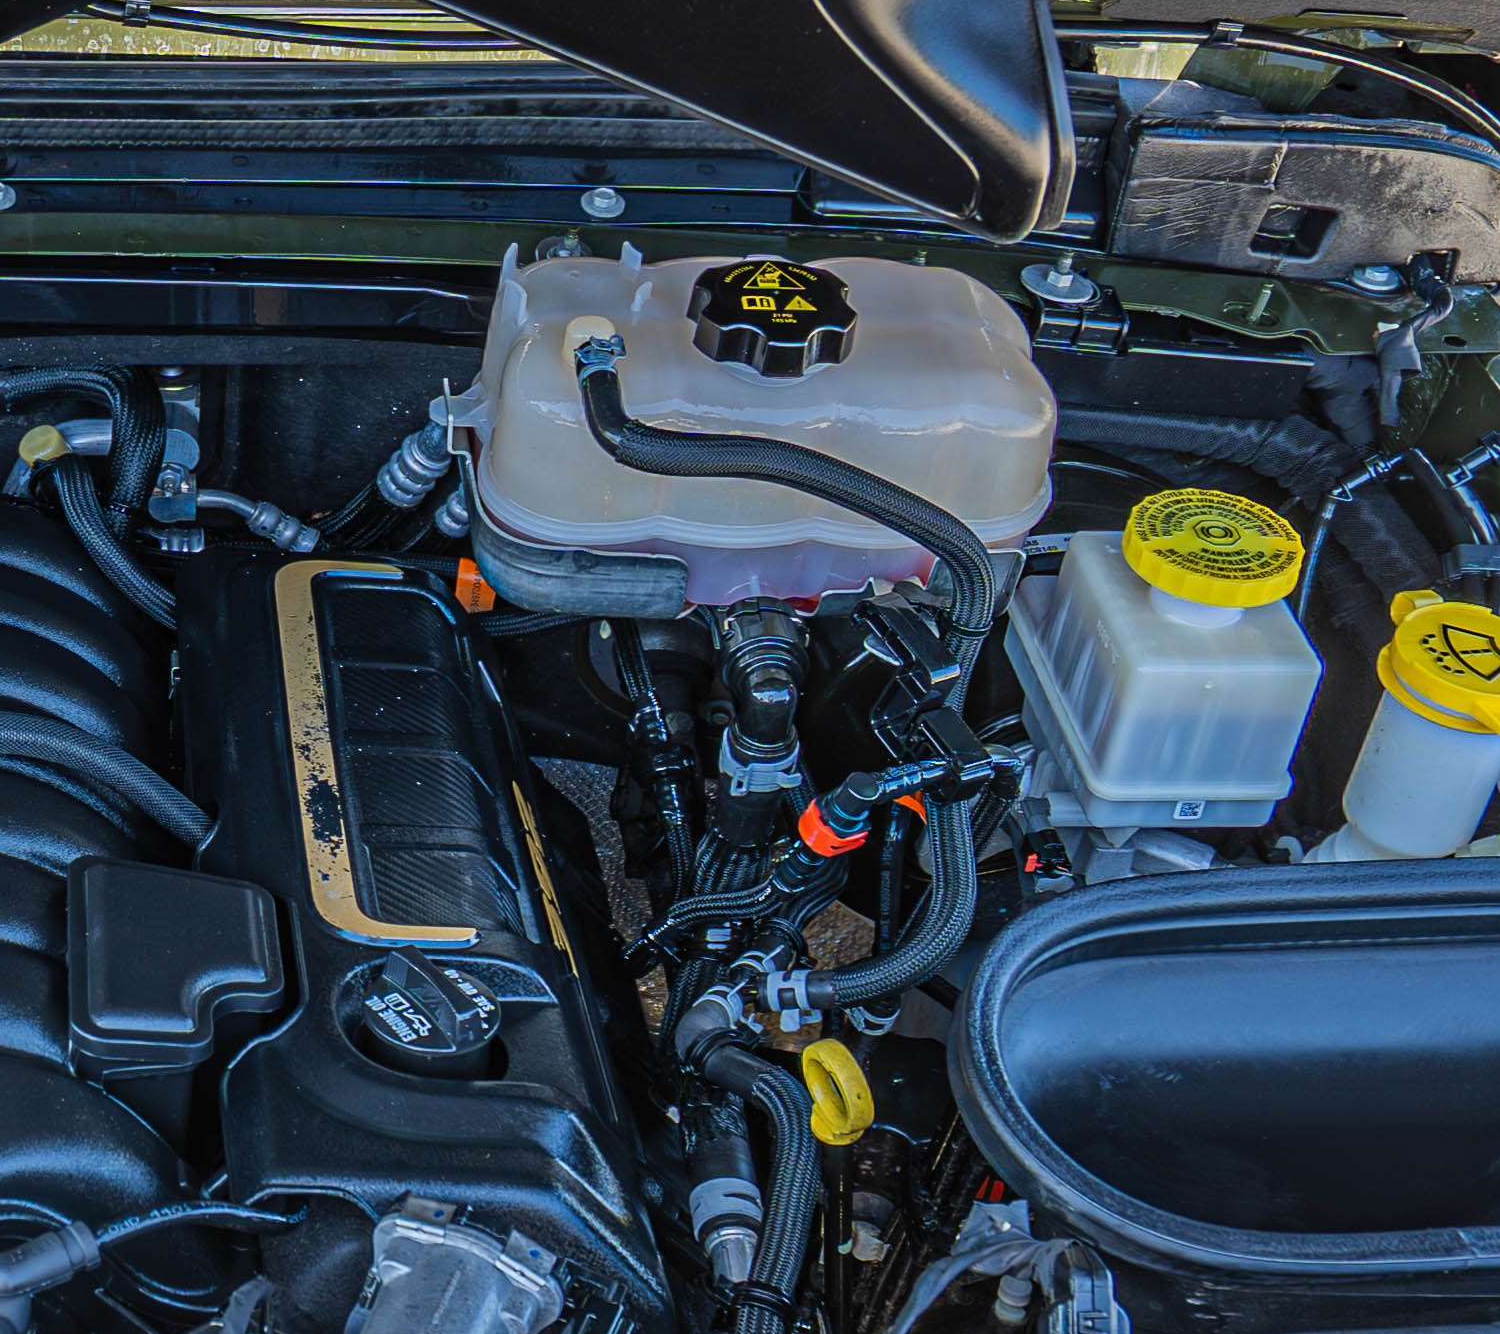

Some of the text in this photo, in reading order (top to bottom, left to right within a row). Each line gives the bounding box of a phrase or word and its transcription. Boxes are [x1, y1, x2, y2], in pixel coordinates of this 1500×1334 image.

[364, 994, 419, 1043] ENGINE OIL
[471, 994, 496, 1013] SAE
